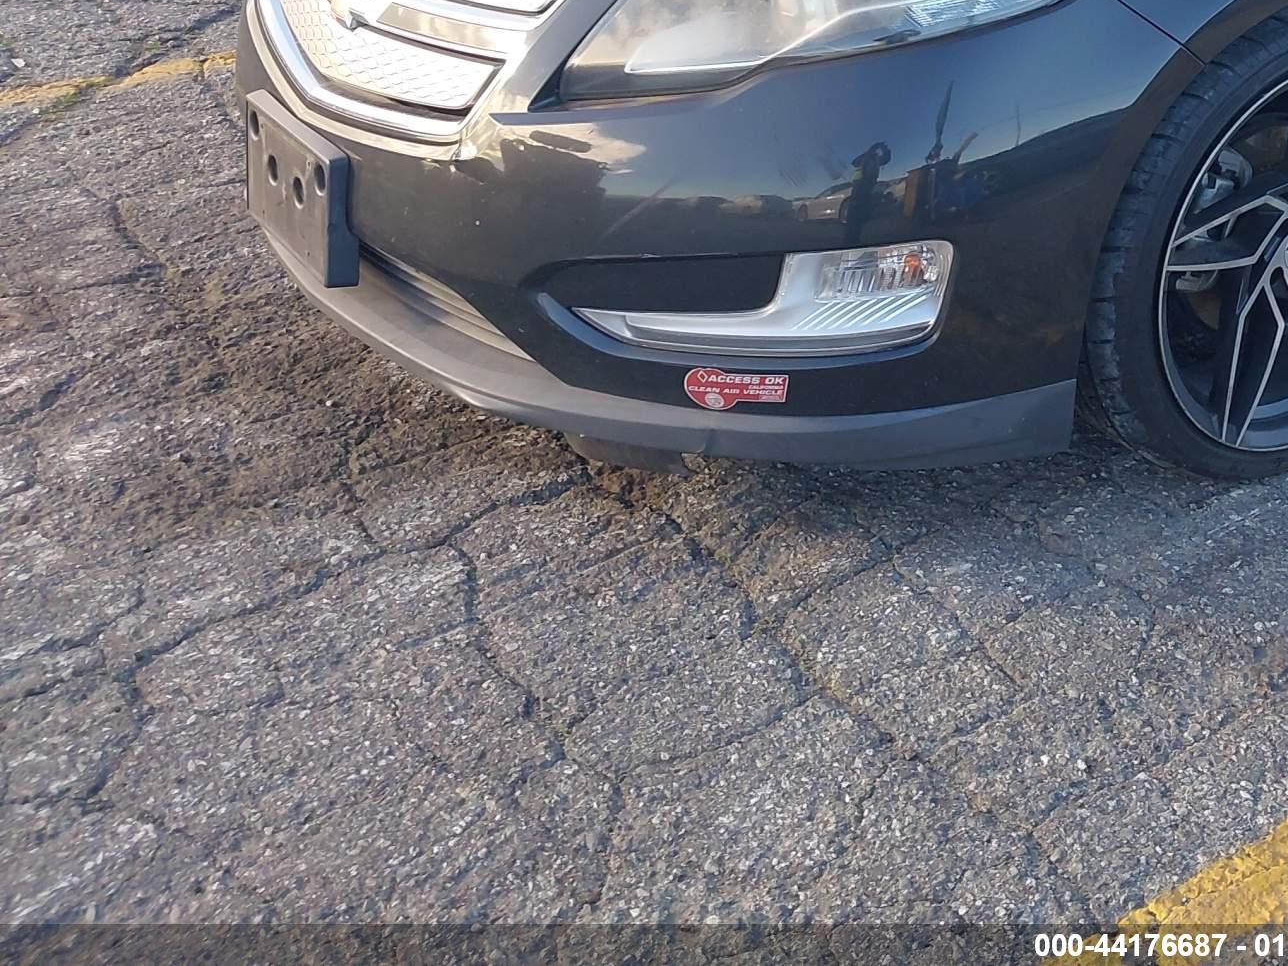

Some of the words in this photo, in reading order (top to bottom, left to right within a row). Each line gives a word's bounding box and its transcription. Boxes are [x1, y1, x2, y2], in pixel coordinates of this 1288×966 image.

[708, 375, 760, 385] ACCESS
[765, 376, 785, 385] OK
[688, 385, 720, 393] CLEAN
